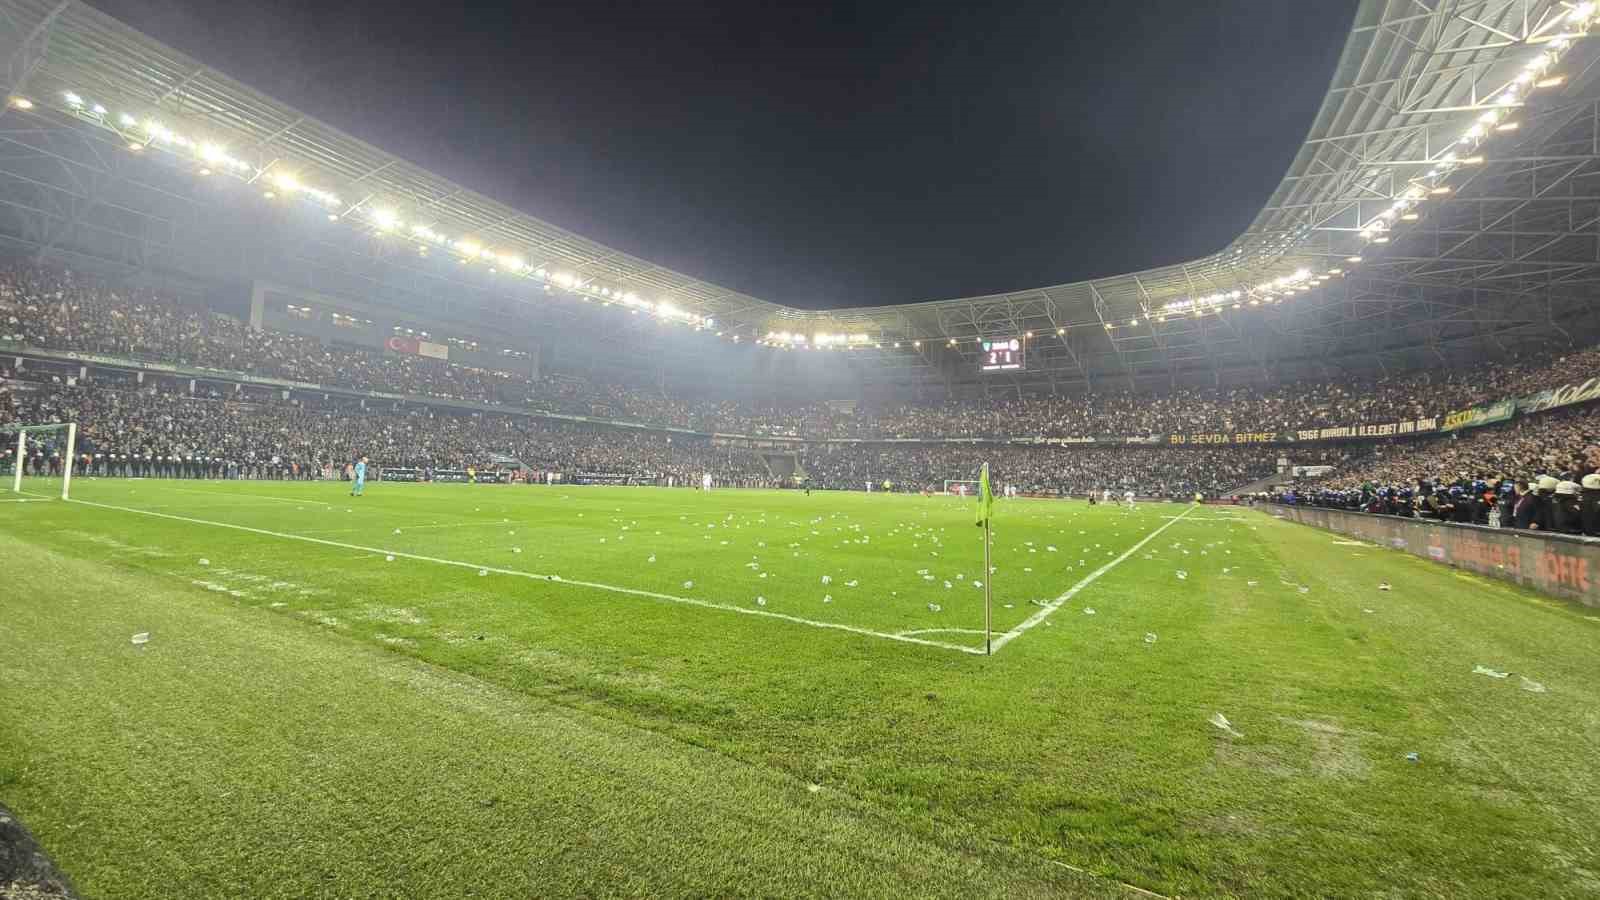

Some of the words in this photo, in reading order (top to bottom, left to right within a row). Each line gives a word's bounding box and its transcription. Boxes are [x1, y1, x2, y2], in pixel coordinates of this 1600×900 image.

[990, 352, 997, 364] 2
[1171, 434, 1186, 444] BU
[1191, 433, 1230, 444] SEVDA
[1297, 430, 1319, 440] 1966
